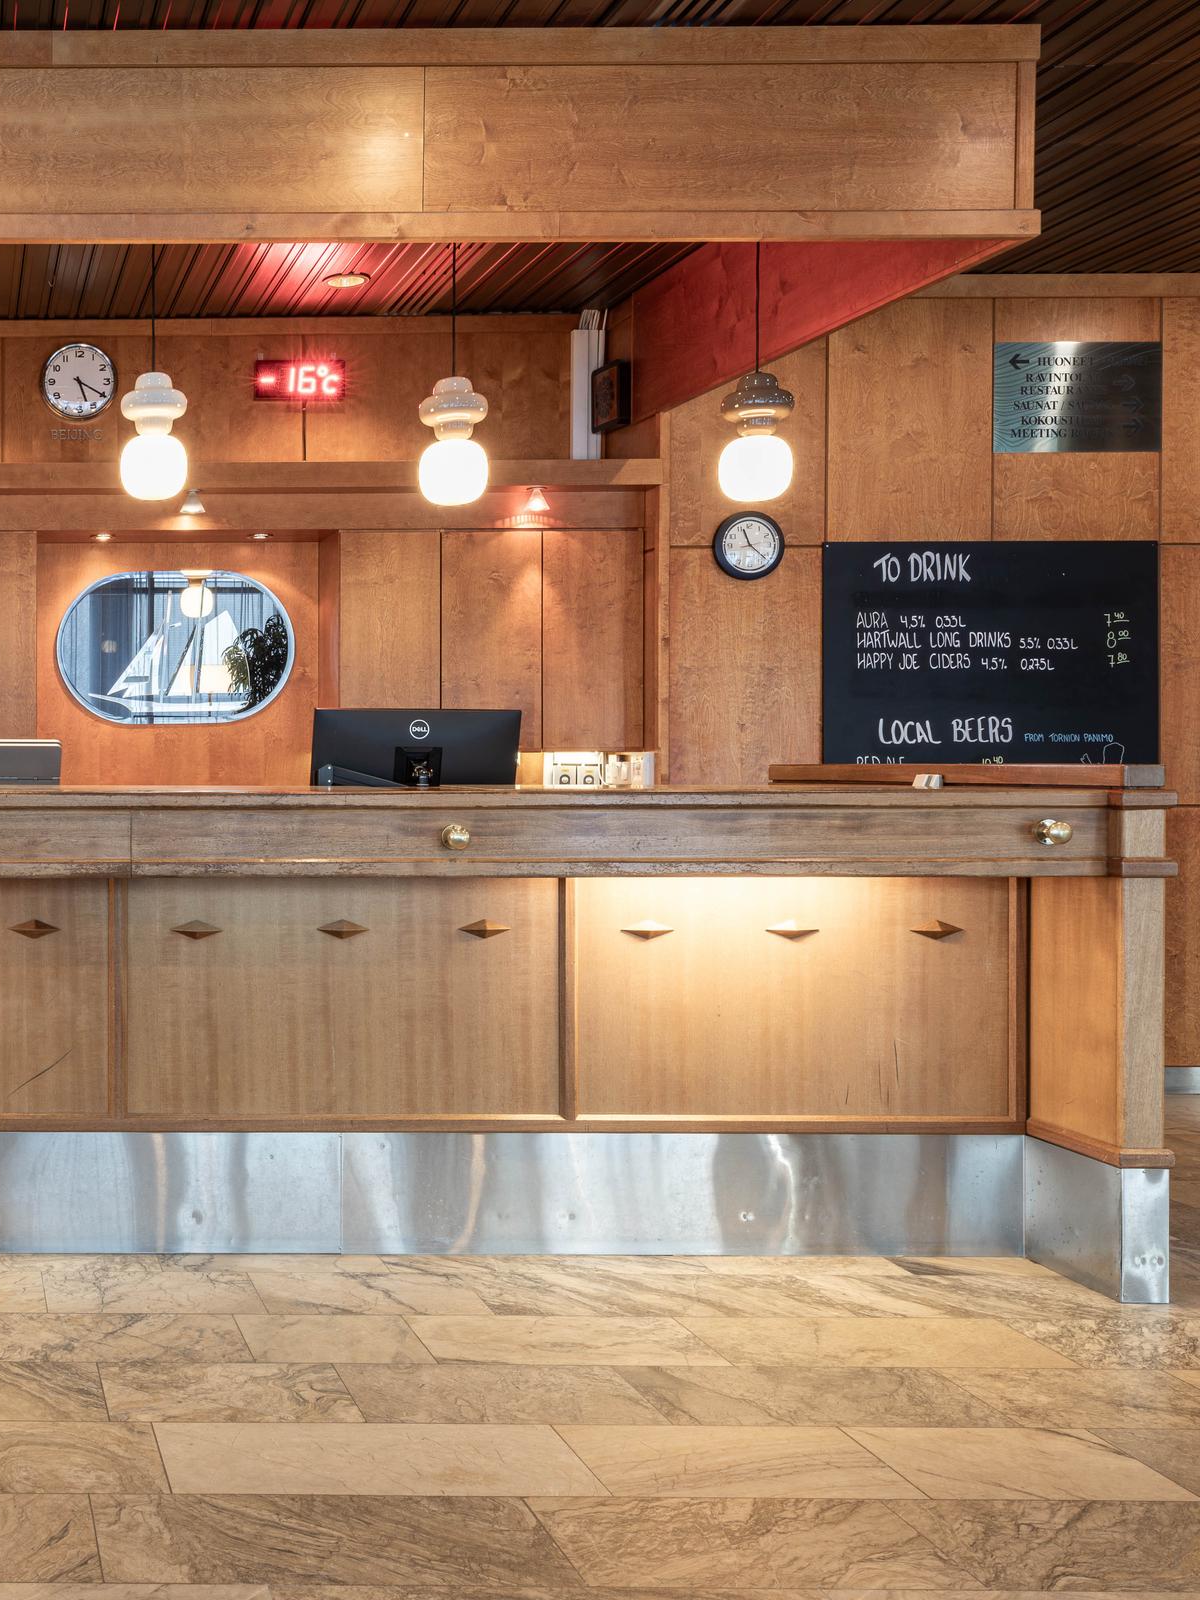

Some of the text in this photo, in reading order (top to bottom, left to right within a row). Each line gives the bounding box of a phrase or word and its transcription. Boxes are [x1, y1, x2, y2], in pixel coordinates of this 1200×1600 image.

[1038, 357, 1094, 366] HUONEET
[52, 364, 61, 372] 10
[48, 378, 56, 386] 9
[103, 378, 111, 386] 3
[1013, 401, 1058, 410] SAUNAT
[51, 429, 103, 440] BEIJING
[1011, 429, 1066, 438] MEETING
[873, 551, 972, 583] TO DRINK
[856, 611, 889, 629] AURA
[857, 629, 922, 649] HARTWALL
[929, 631, 961, 648] LONG
[969, 631, 1012, 648] DRINKS
[857, 653, 894, 670] HAPPY
[898, 653, 920, 670] JOE
[929, 653, 971, 669] CIDERS
[878, 716, 1114, 745] LOCAL BEERS FROM TORNION PANIMO
